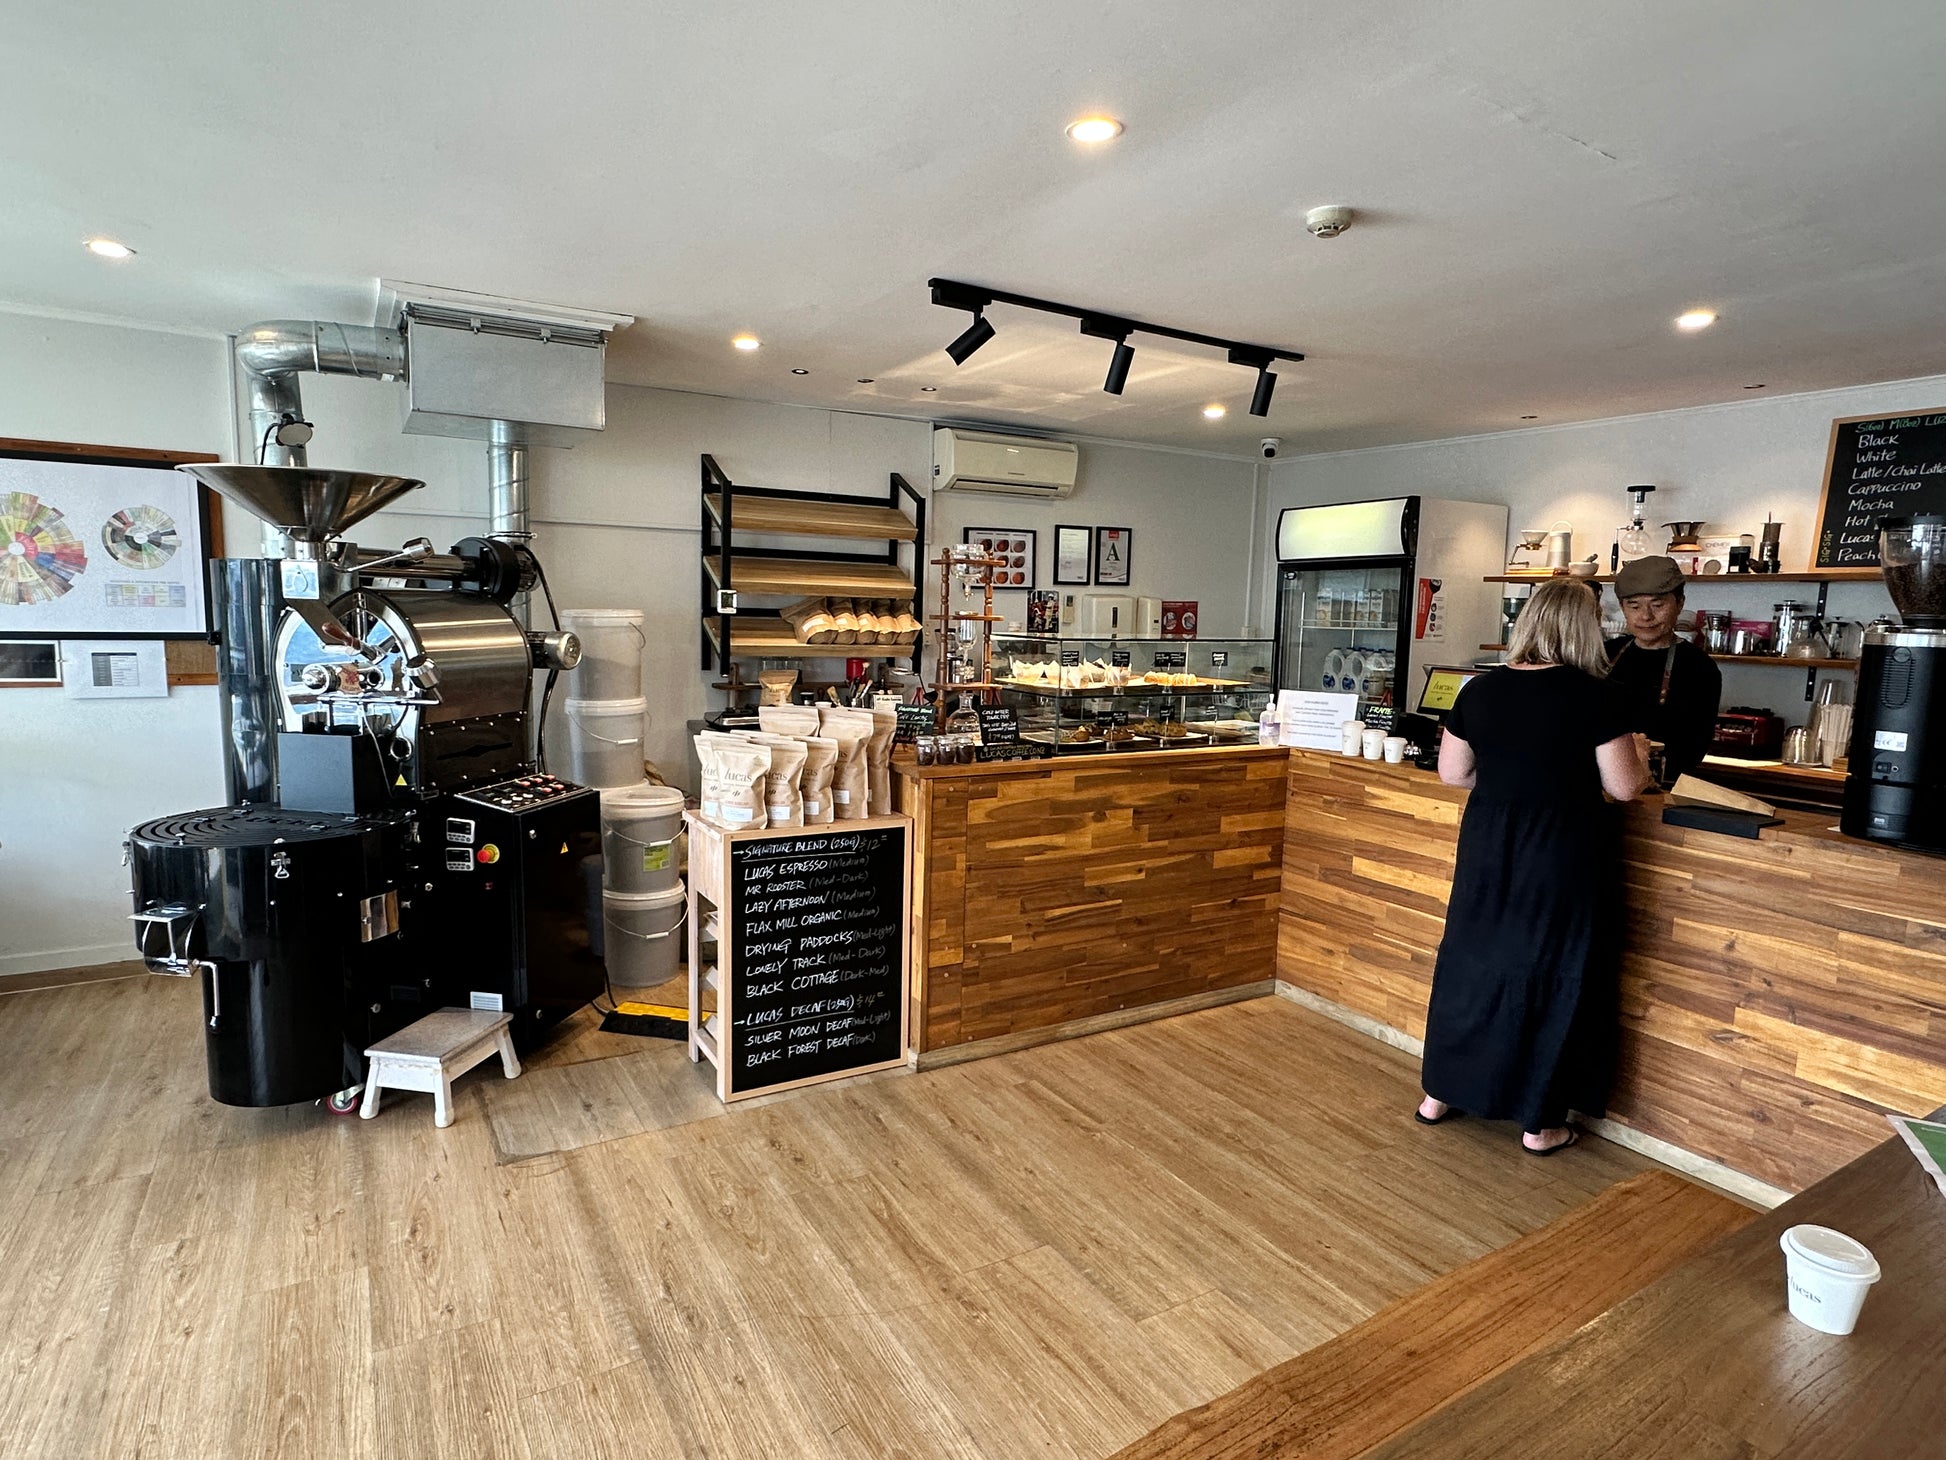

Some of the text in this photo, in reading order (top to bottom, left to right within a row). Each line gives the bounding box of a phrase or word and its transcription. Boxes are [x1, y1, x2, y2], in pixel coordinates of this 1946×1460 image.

[1858, 434, 1900, 448] Black
[1856, 449, 1897, 464] White
[1848, 481, 1922, 496] Cappuccino
[1848, 499, 1894, 512] Mocha
[1845, 514, 1870, 528] Hot
[1106, 542, 1120, 562] A
[1838, 548, 1876, 562] Peach
[1433, 680, 1454, 691] lucas
[704, 763, 716, 776] luc
[724, 768, 752, 782] lucas
[743, 842, 794, 859] SIGNATURE
[795, 840, 827, 852] BLEND
[744, 855, 869, 881] LUCAS ESPRESSO (Medium)
[745, 884, 761, 896] MR
[766, 880, 807, 893] ROOSTER
[745, 887, 876, 914] LAZY AFTERNOON (Medium)
[746, 906, 880, 936] FLAX MILL ORGANIC (Medium)
[745, 939, 792, 957] DRYING
[800, 930, 854, 950] PADDOCKS
[746, 958, 788, 977] LONELY
[792, 953, 827, 970] TRACK
[746, 981, 784, 998] BLACK
[791, 969, 839, 990] COTTAGE
[747, 1007, 784, 1026] LUCAS
[791, 1000, 827, 1018] DECAF
[789, 1023, 821, 1039] MOON
[826, 1017, 852, 1032] DECAF
[746, 1049, 782, 1067] BLACK
[788, 1039, 823, 1058] FOREST
[826, 1033, 854, 1049] DECAF
[1790, 1276, 1822, 1304] lucas
